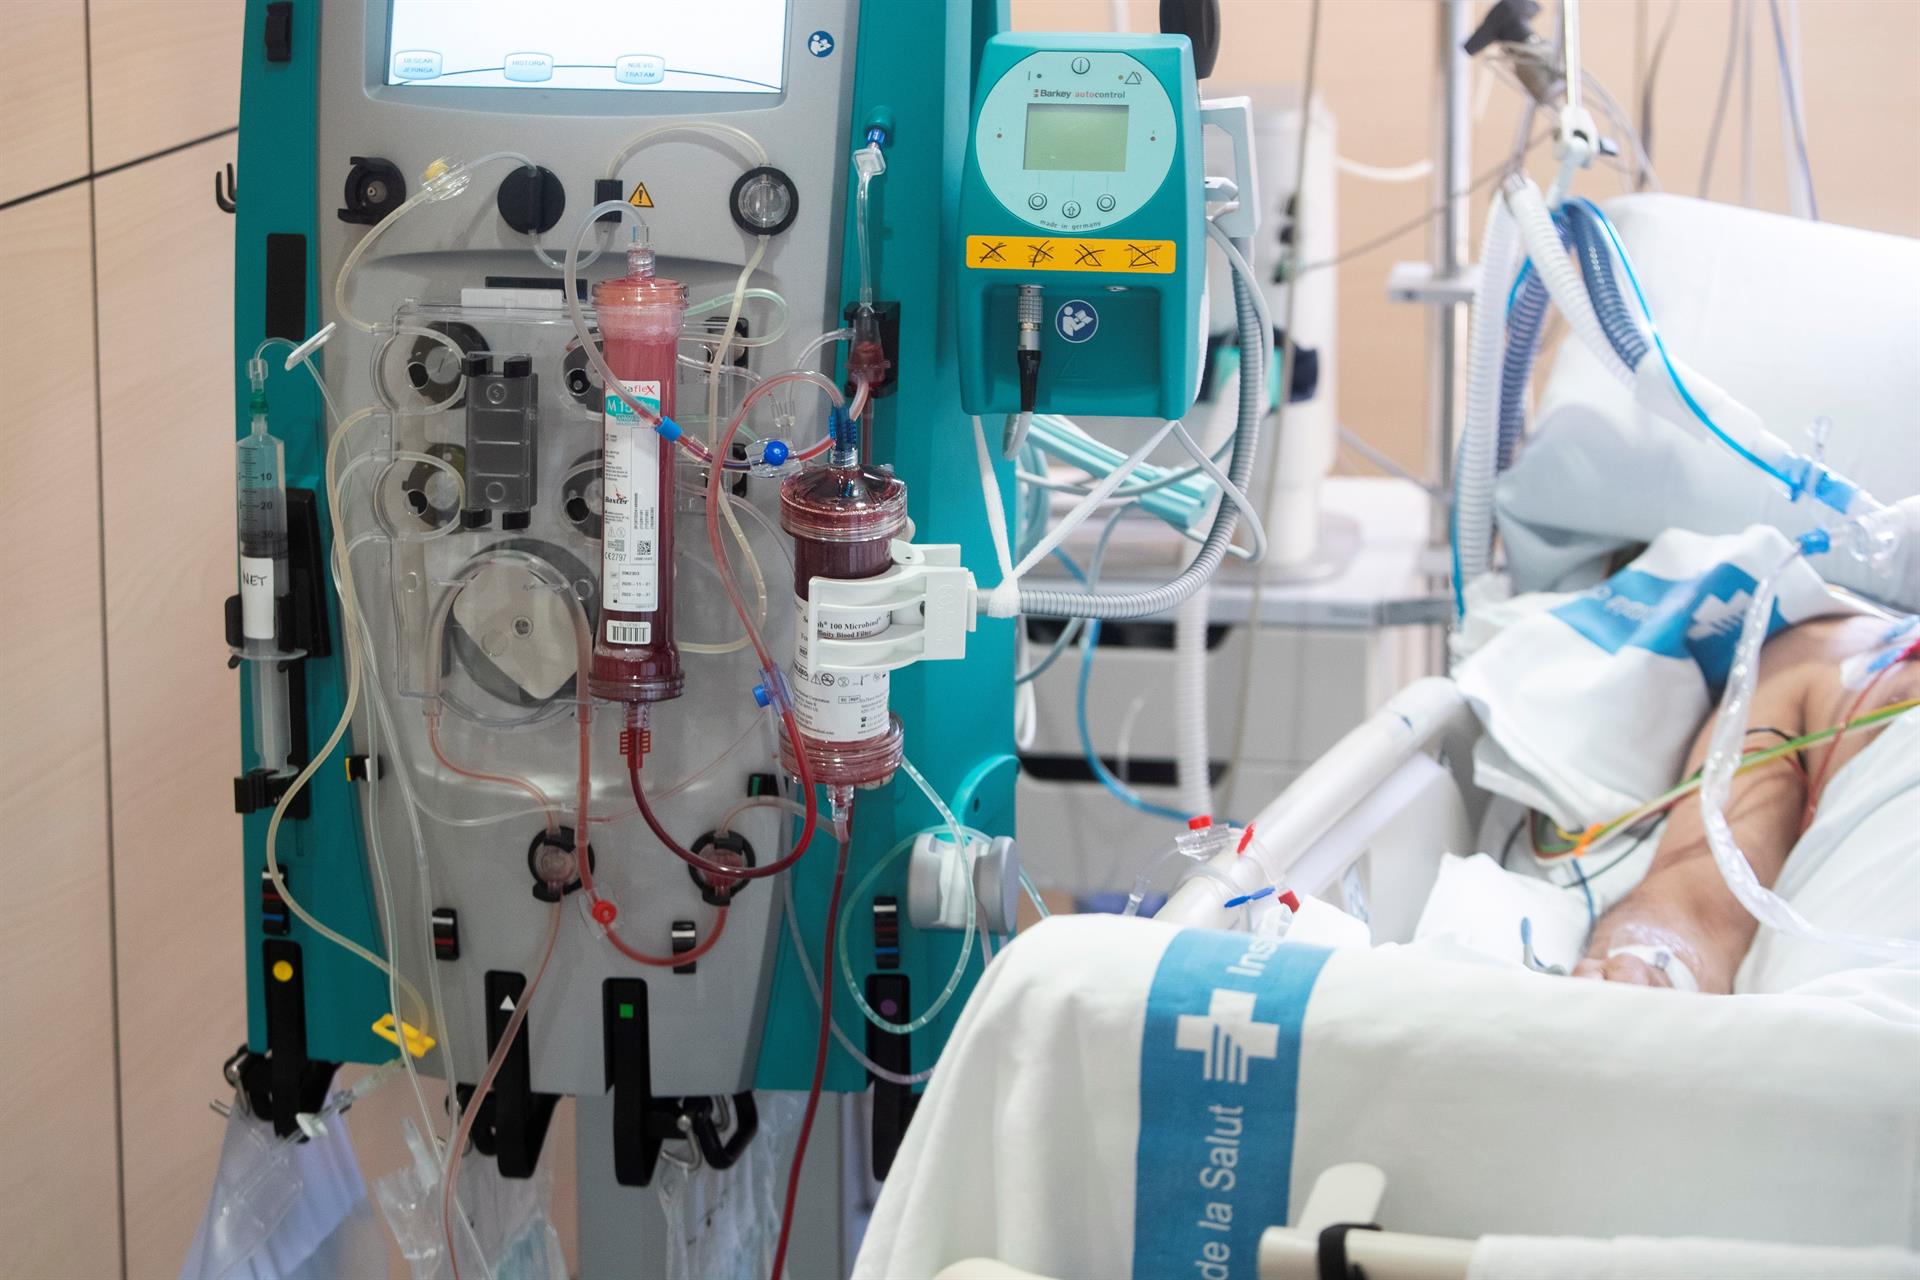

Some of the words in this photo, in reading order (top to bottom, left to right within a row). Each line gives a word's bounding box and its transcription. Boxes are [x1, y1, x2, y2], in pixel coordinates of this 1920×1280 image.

[1040, 89, 1071, 99] Barkey
[1074, 91, 1126, 99] autocontrol
[1040, 220, 1057, 228] made
[260, 472, 272, 481] 10
[604, 496, 628, 505] Baxter
[260, 501, 273, 510] 20
[856, 630, 873, 638] Filter
[1226, 937, 1279, 978] Ins
[1199, 1104, 1244, 1192] Salut
[1197, 1201, 1233, 1231] la
[1194, 1240, 1232, 1280] de
